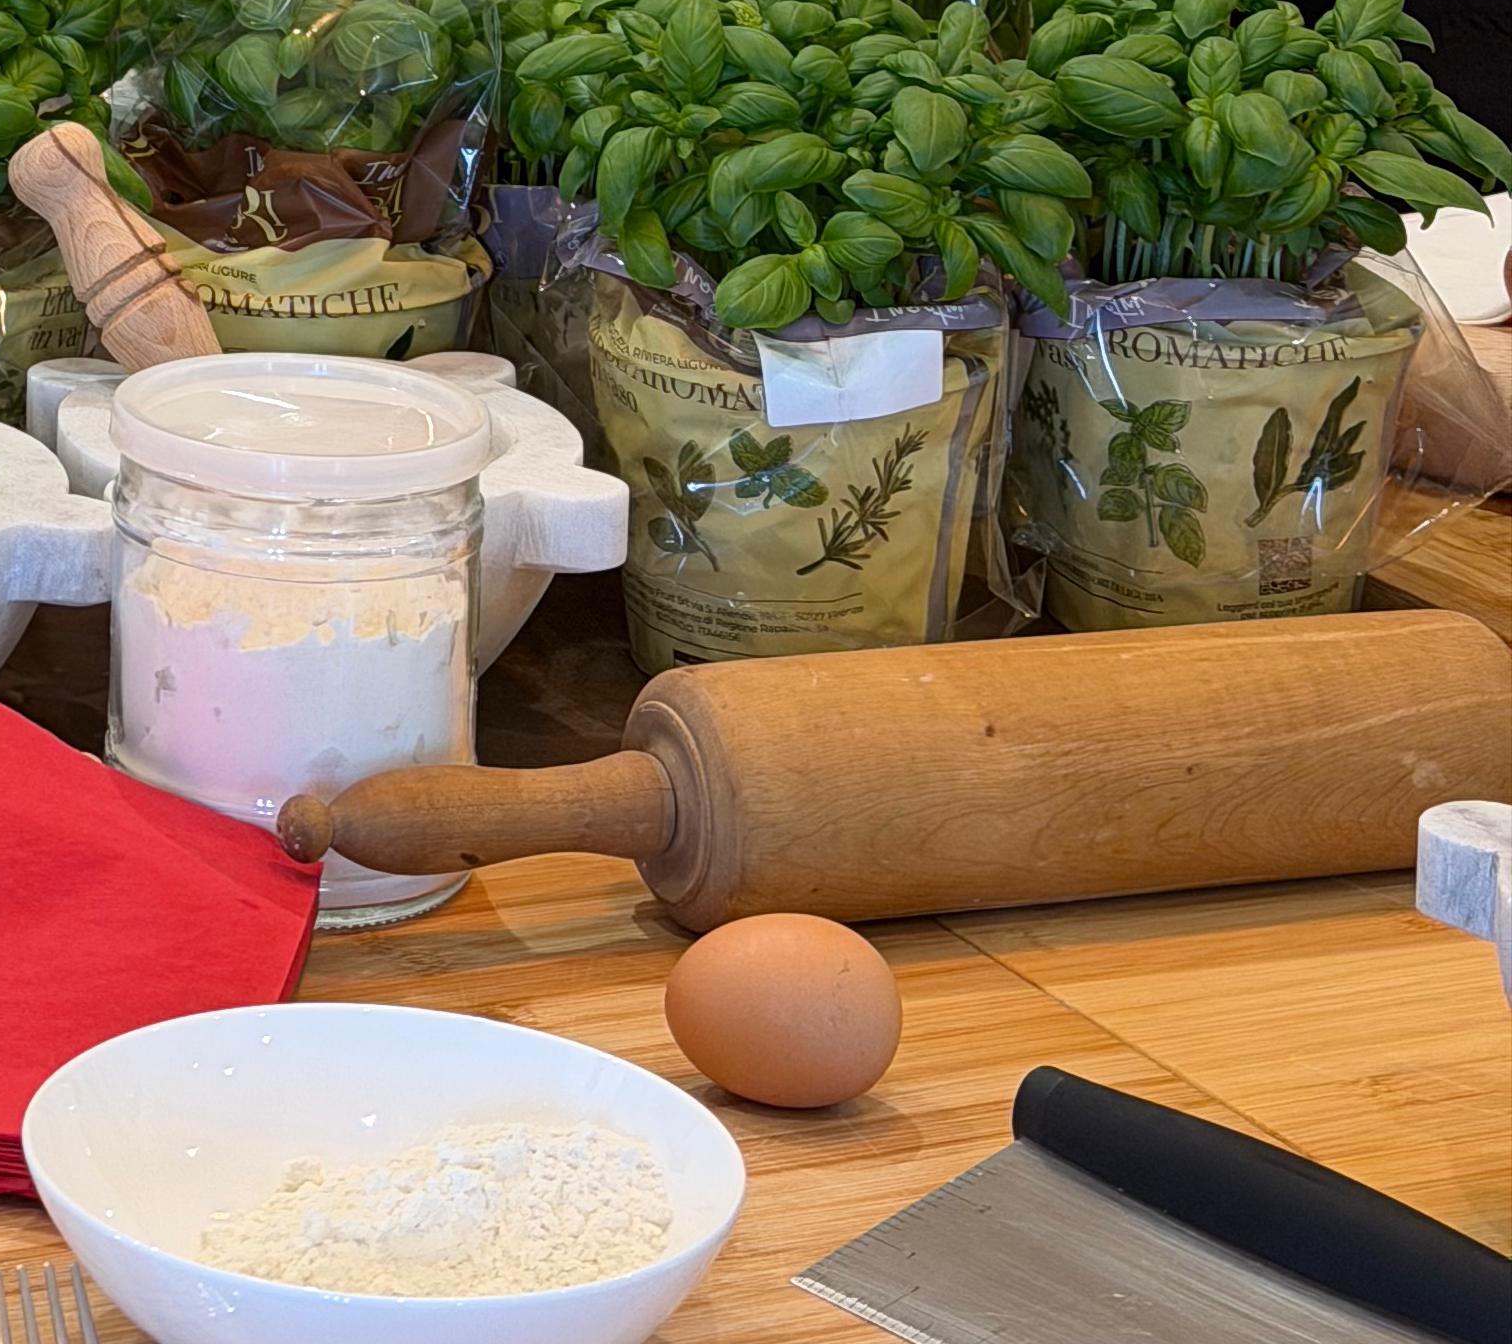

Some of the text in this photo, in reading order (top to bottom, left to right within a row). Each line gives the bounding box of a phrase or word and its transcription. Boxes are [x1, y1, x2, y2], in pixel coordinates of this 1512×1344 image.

[210, 264, 258, 284] LIGURE
[194, 282, 403, 320] OMATICHE
[1108, 326, 1354, 370] ROMATICHE
